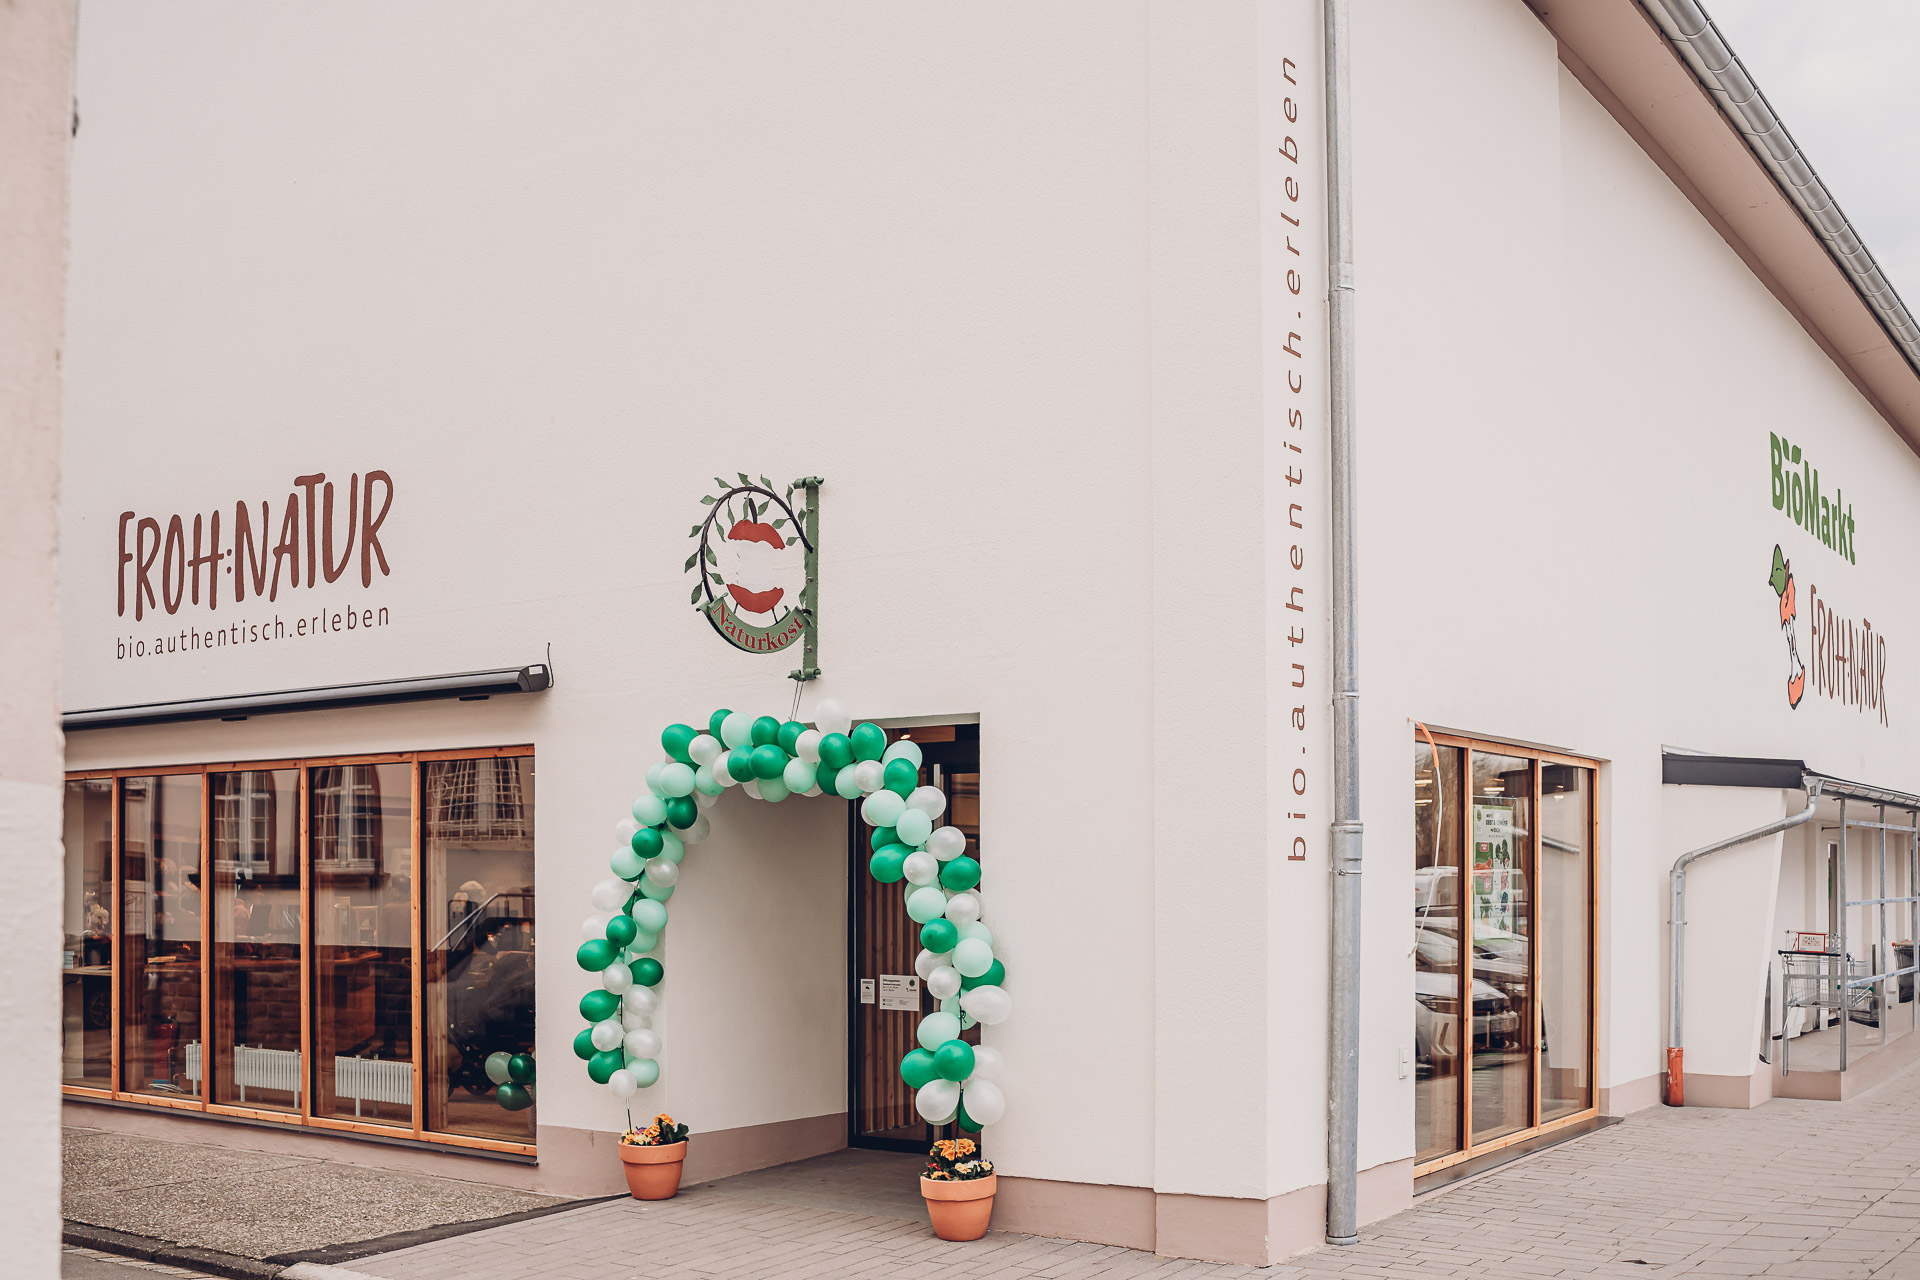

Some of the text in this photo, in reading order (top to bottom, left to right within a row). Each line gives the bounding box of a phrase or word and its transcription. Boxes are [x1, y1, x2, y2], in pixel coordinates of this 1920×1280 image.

[1278, 57, 1307, 862] bio.authentisch.erleben
[117, 470, 394, 622] FROH:NATUR
[116, 604, 390, 660] bio.authentisch.erleben
[713, 602, 804, 651] Naturkost
[1810, 584, 1888, 728] FROH:NATUR
